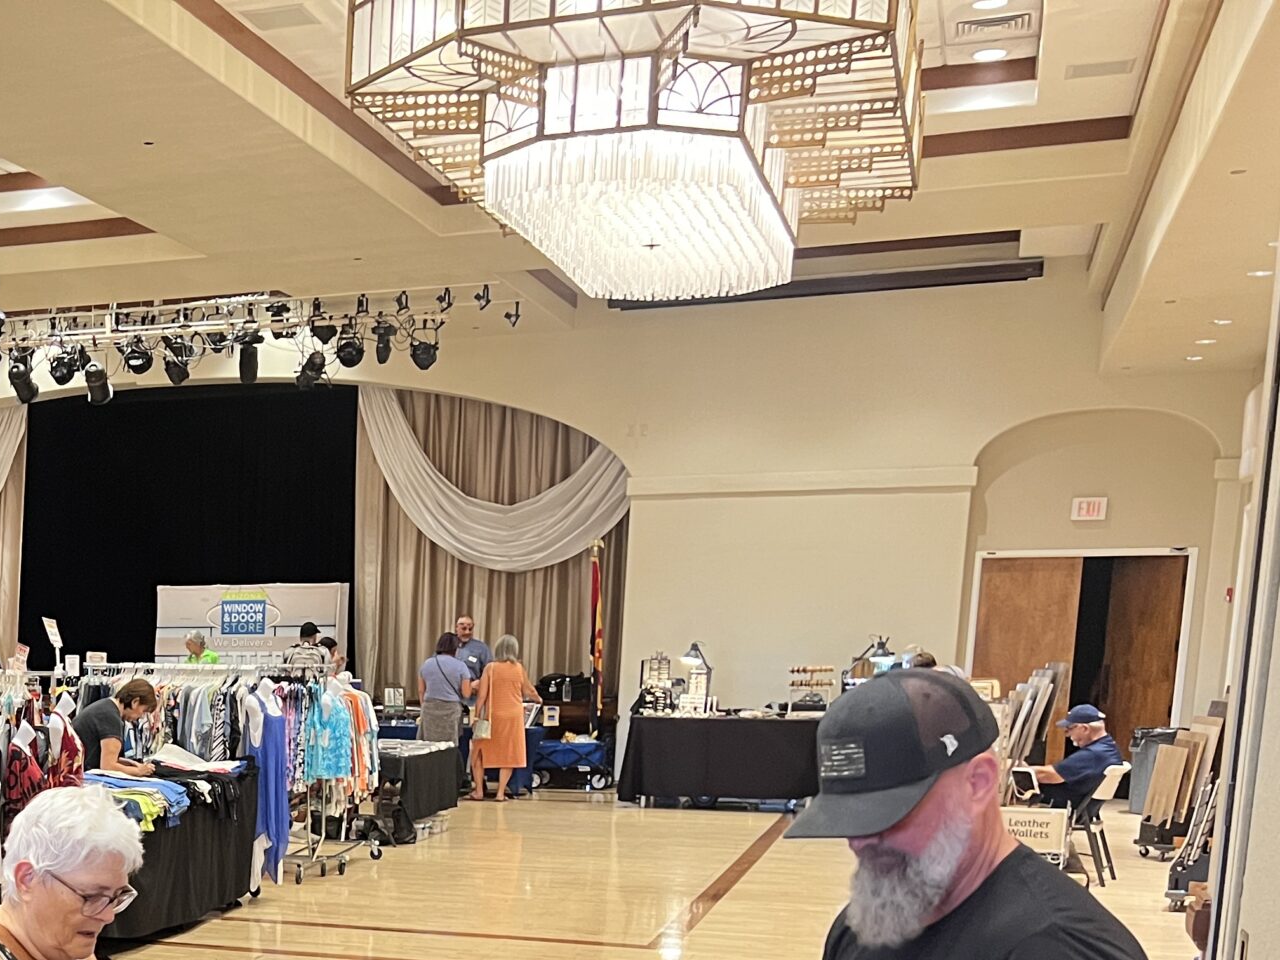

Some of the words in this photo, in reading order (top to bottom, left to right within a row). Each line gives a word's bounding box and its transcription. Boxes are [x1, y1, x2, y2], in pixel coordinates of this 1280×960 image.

[223, 603, 264, 612] WINDOW
[223, 623, 263, 633] STORE
[213, 638, 229, 647] We
[231, 638, 265, 647] Deliver
[1008, 818, 1051, 829] Leather
